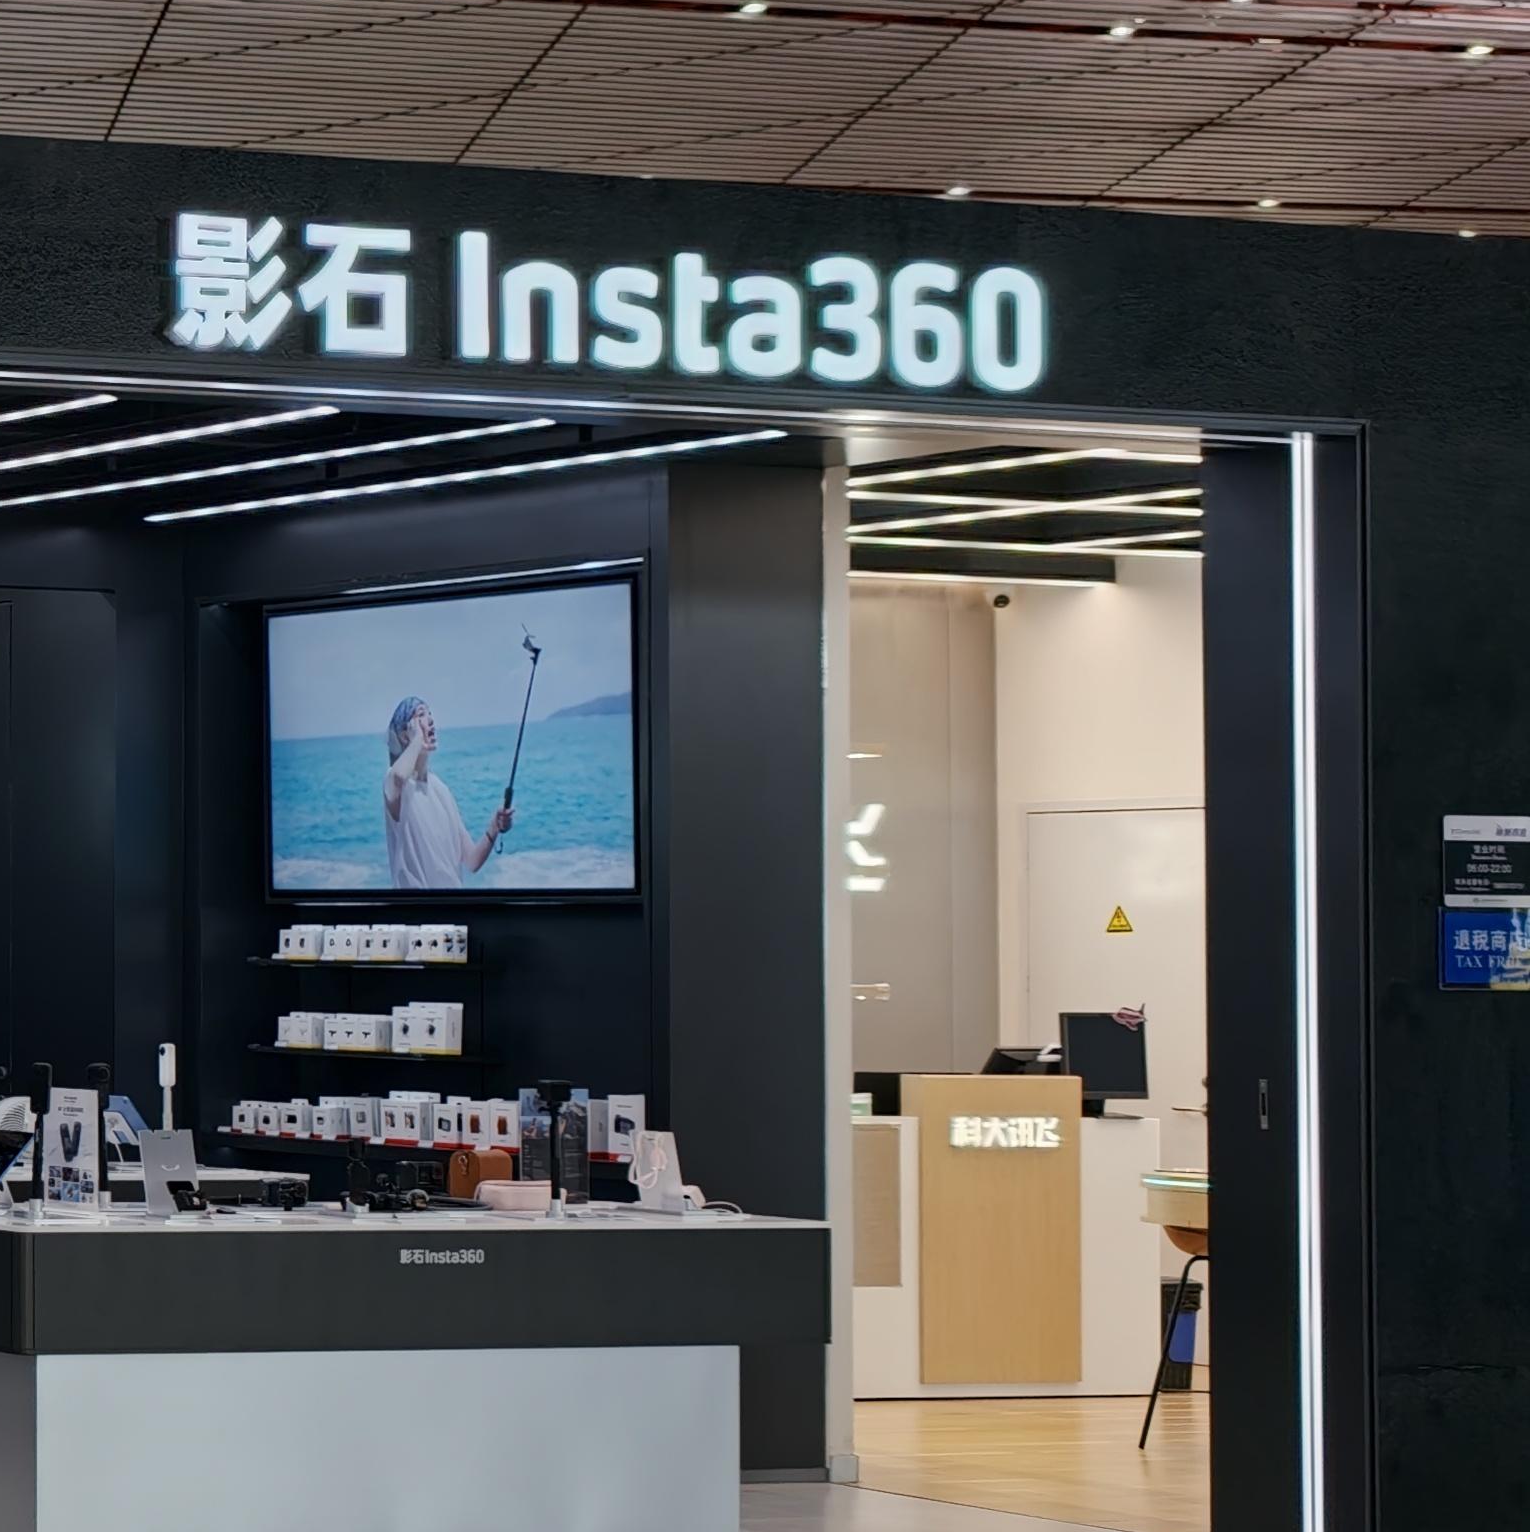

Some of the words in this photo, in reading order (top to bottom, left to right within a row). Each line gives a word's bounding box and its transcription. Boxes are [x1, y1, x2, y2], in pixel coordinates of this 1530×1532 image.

[173, 211, 411, 356] 影石
[455, 230, 1045, 392] Insta360
[1455, 955, 1483, 968] TAX
[950, 1116, 1061, 1148] 科大讯飞
